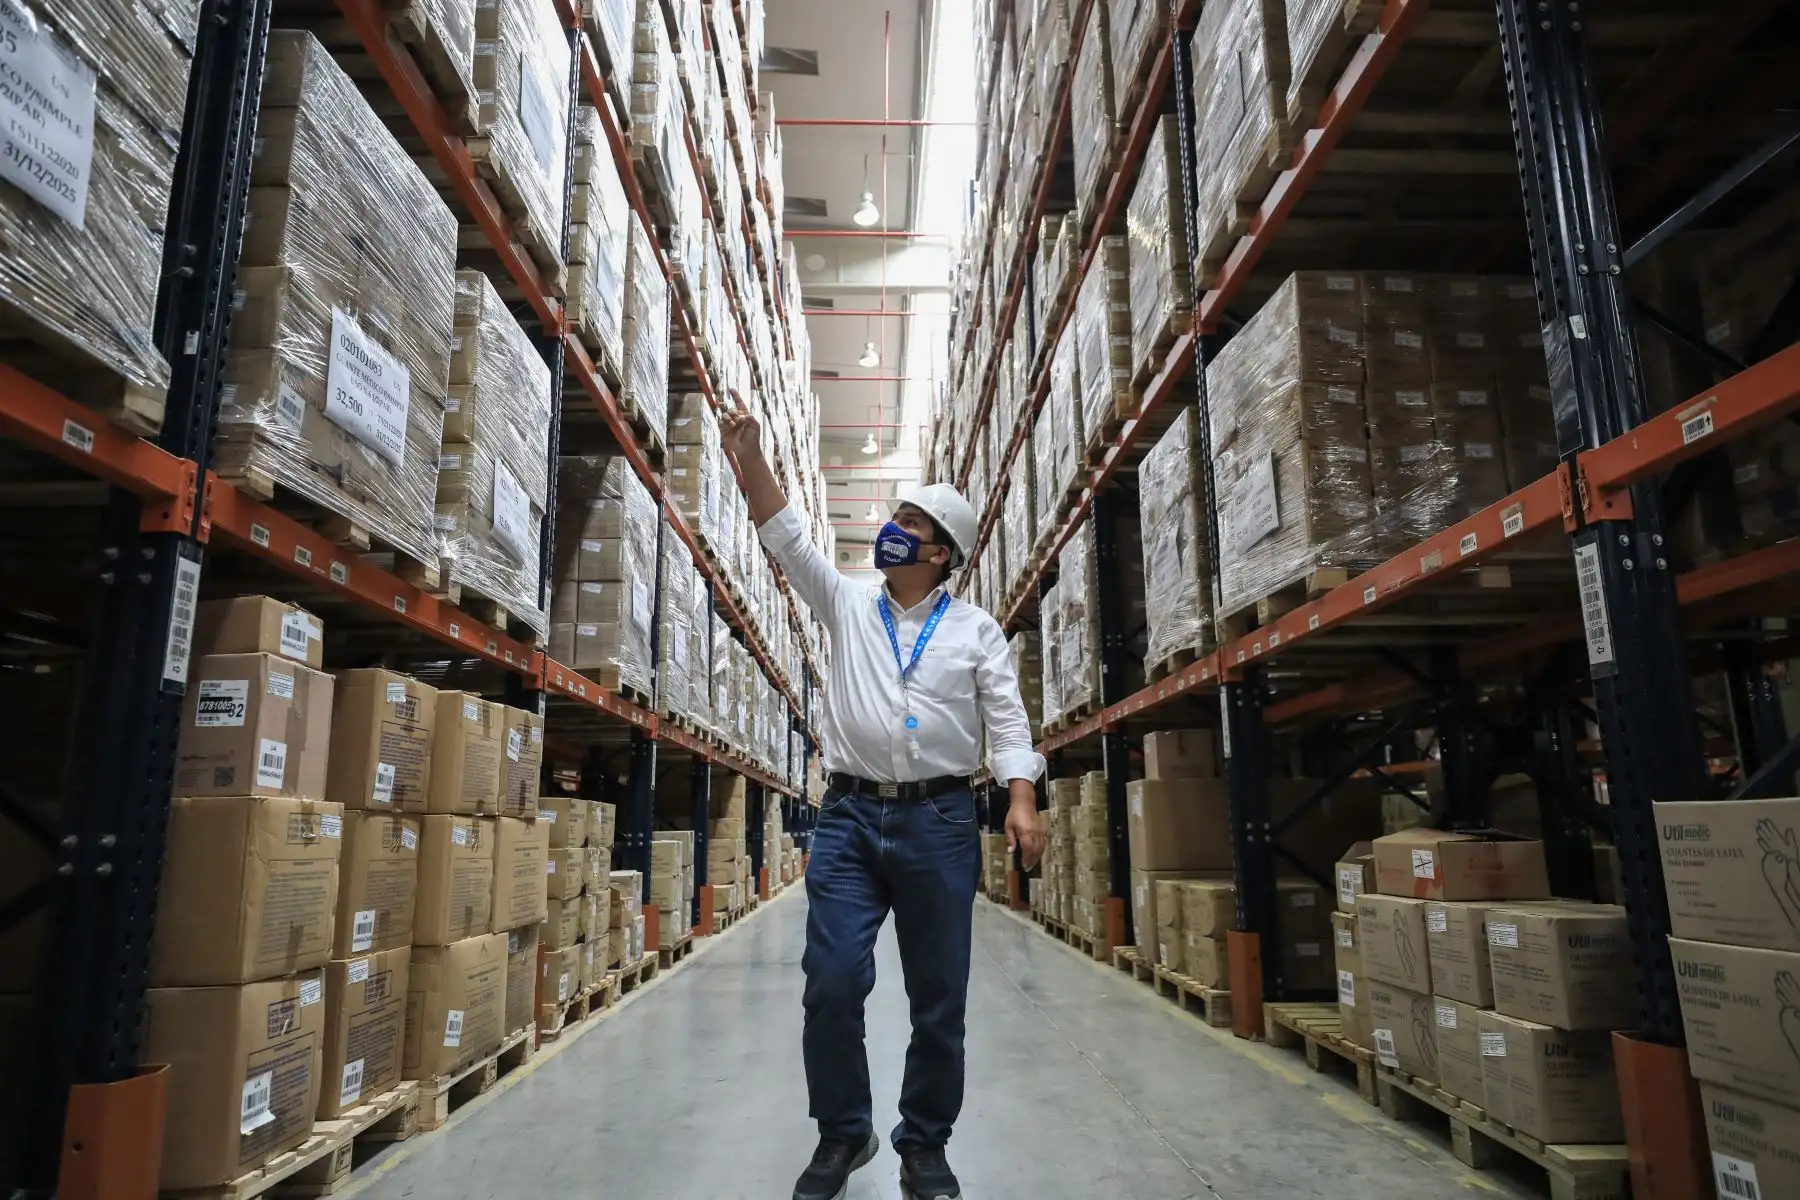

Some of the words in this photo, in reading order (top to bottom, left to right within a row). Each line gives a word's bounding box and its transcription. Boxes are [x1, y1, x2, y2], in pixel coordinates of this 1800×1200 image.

[24, 81, 84, 139] P/SIMPLE
[4, 140, 77, 204] 31/12/2025
[335, 387, 363, 417] 32,500
[1663, 824, 1711, 841] Utilmedic
[1727, 1161, 1740, 1173] UA
